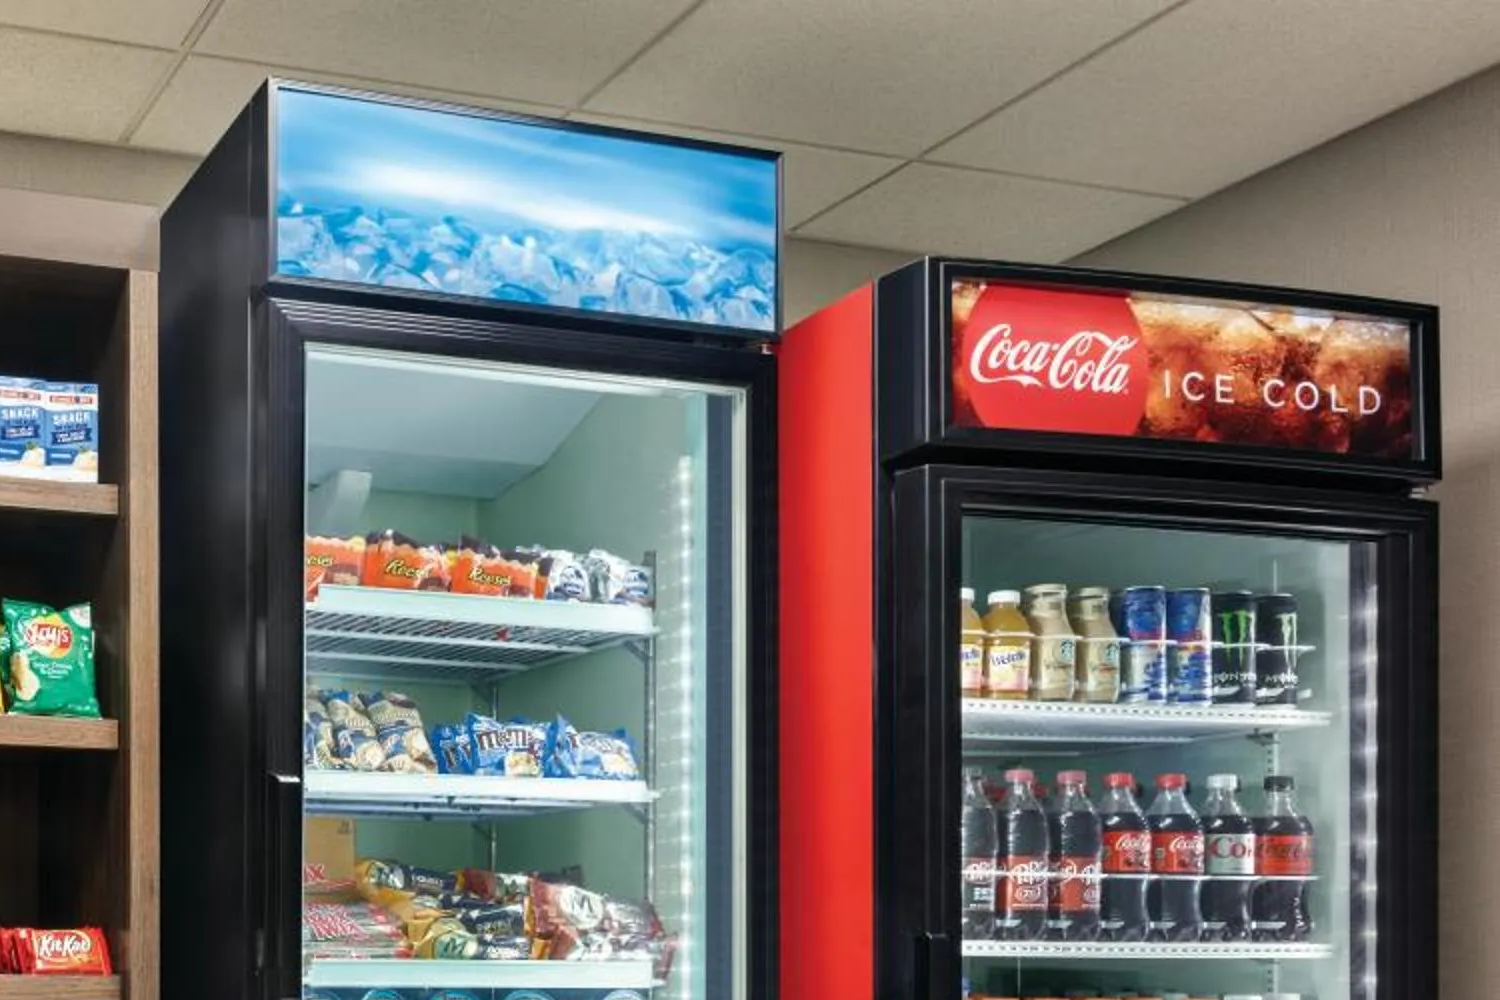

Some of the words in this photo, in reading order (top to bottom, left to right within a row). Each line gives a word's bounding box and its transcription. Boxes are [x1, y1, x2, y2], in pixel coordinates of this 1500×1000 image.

[970, 322, 1138, 395] Coca-Cola
[1163, 369, 1235, 404] ICE
[1263, 379, 1382, 415] COLD
[1, 406, 39, 419] SNACK
[52, 411, 91, 425] SNACK
